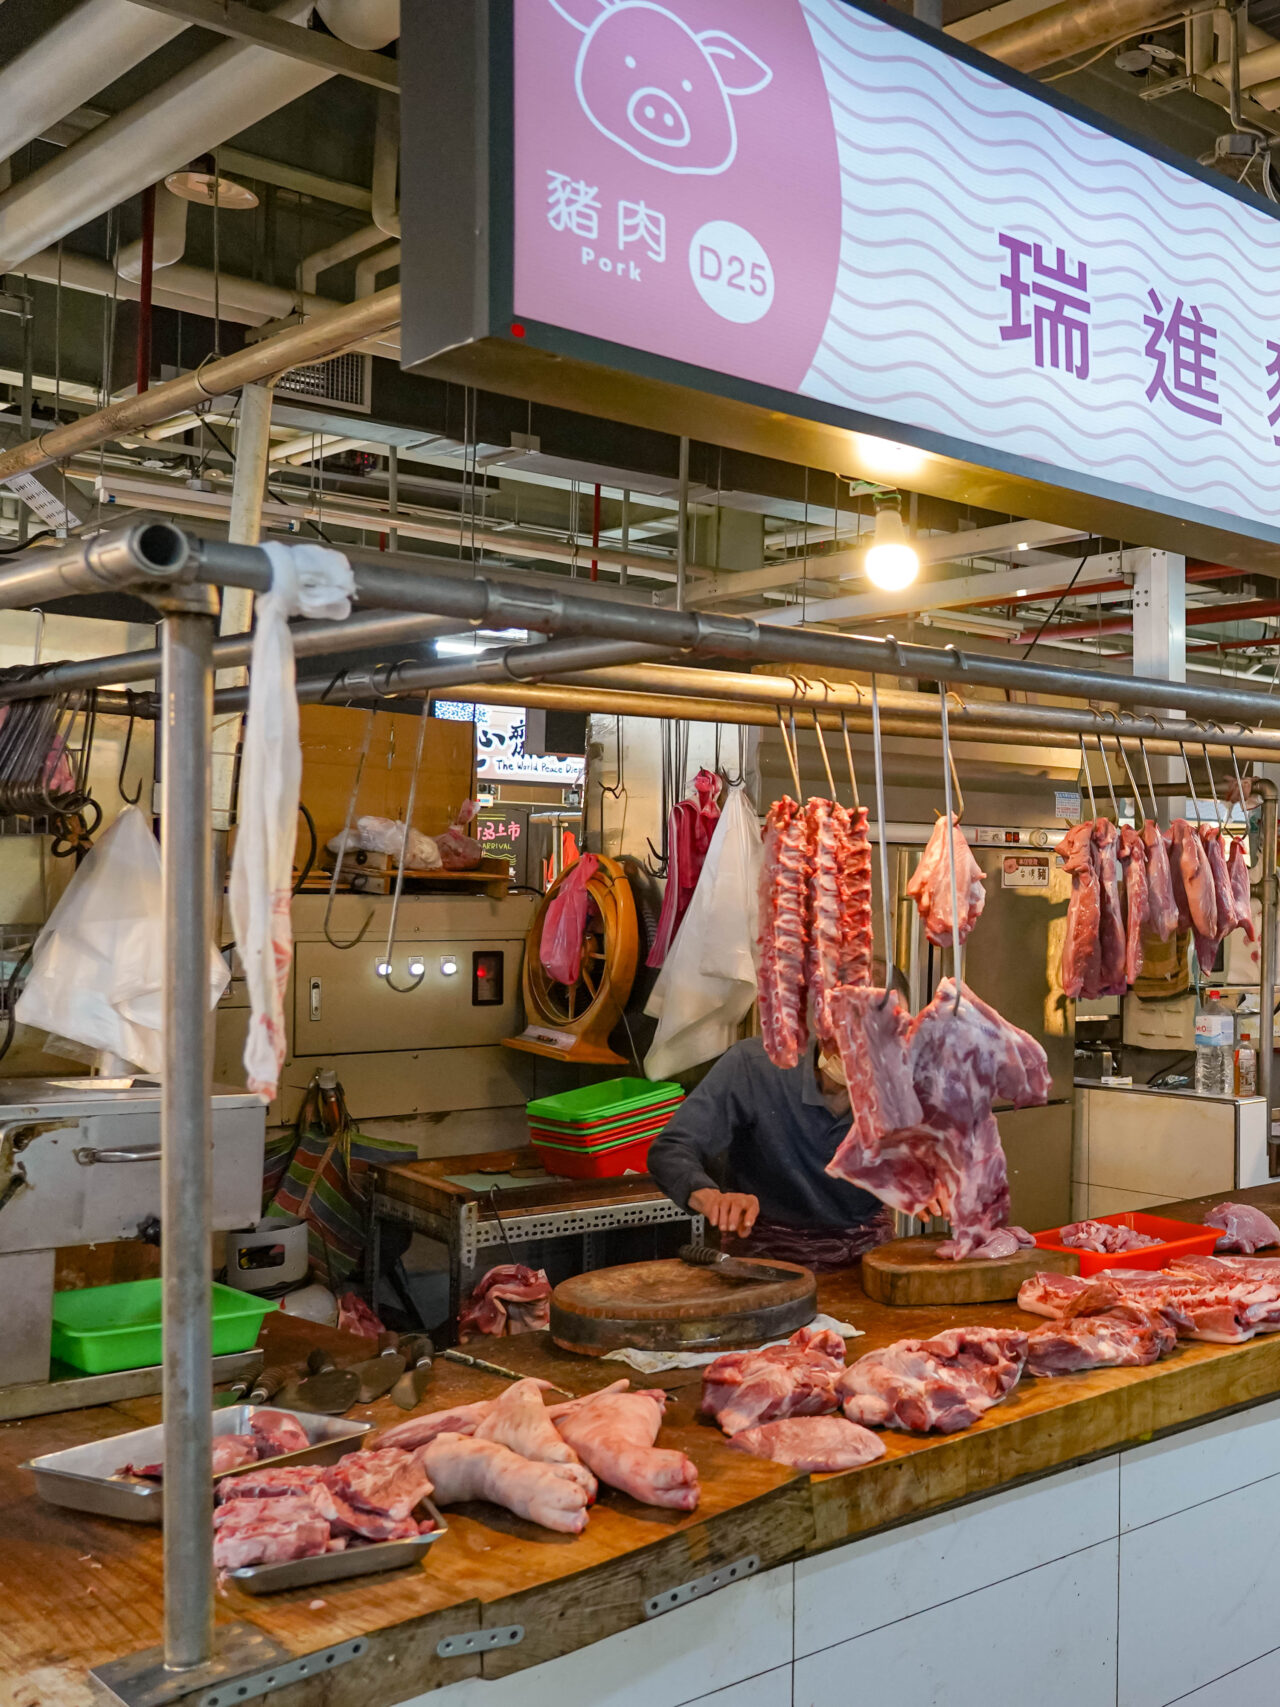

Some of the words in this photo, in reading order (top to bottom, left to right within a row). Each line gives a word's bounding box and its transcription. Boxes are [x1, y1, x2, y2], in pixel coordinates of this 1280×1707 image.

[546, 169, 668, 264] 豬肉
[581, 247, 642, 282] Pork
[699, 244, 767, 298] D25
[496, 759, 514, 771] The
[517, 760, 539, 773] World
[541, 763, 563, 775] Peace
